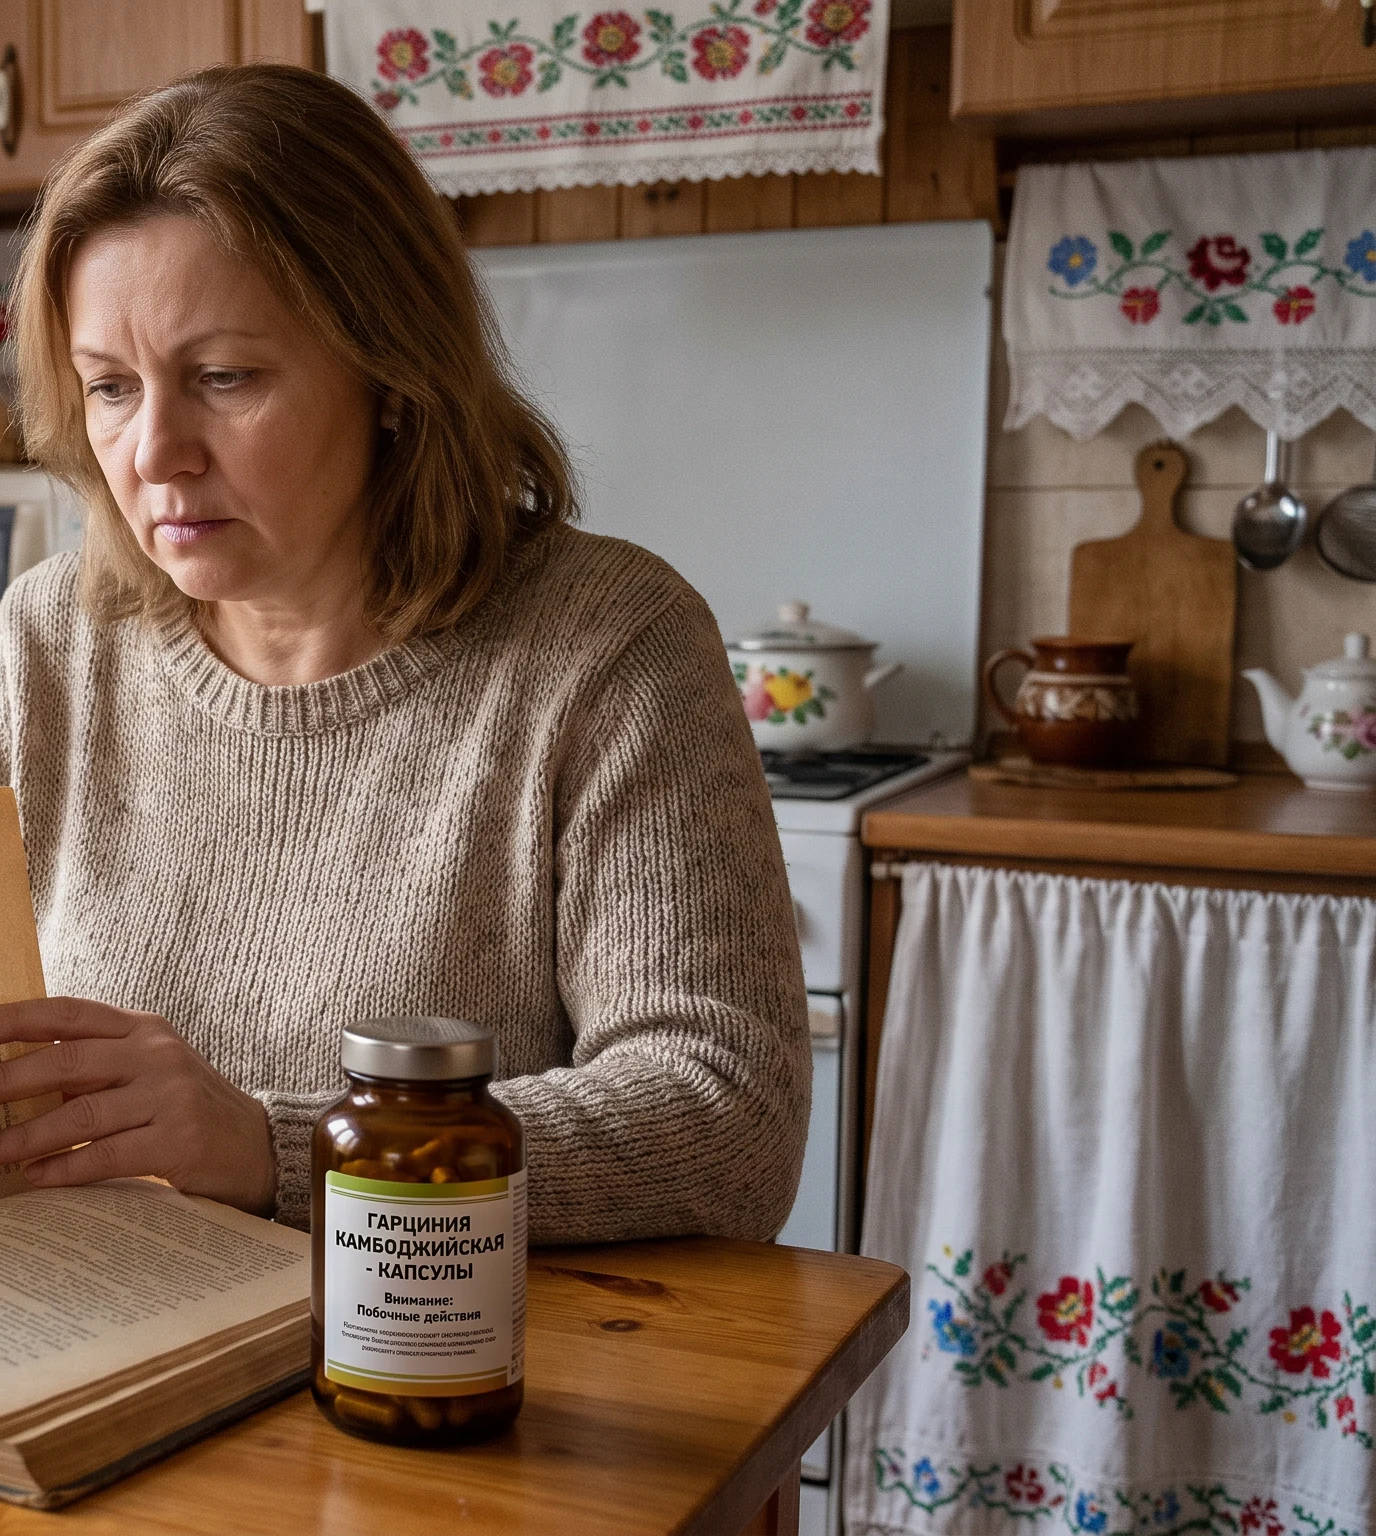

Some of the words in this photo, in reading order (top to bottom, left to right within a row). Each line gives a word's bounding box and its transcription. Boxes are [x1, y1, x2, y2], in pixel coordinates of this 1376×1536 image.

[367, 1212, 471, 1237] ГАРЦИНИЯ
[335, 1229, 505, 1260] КАМБОДЖИЙСКАЯ
[378, 1262, 473, 1281] КАПСУЛЫ
[384, 1292, 454, 1307] Внимание:
[356, 1304, 421, 1322] Побочные
[424, 1310, 481, 1324] действия
